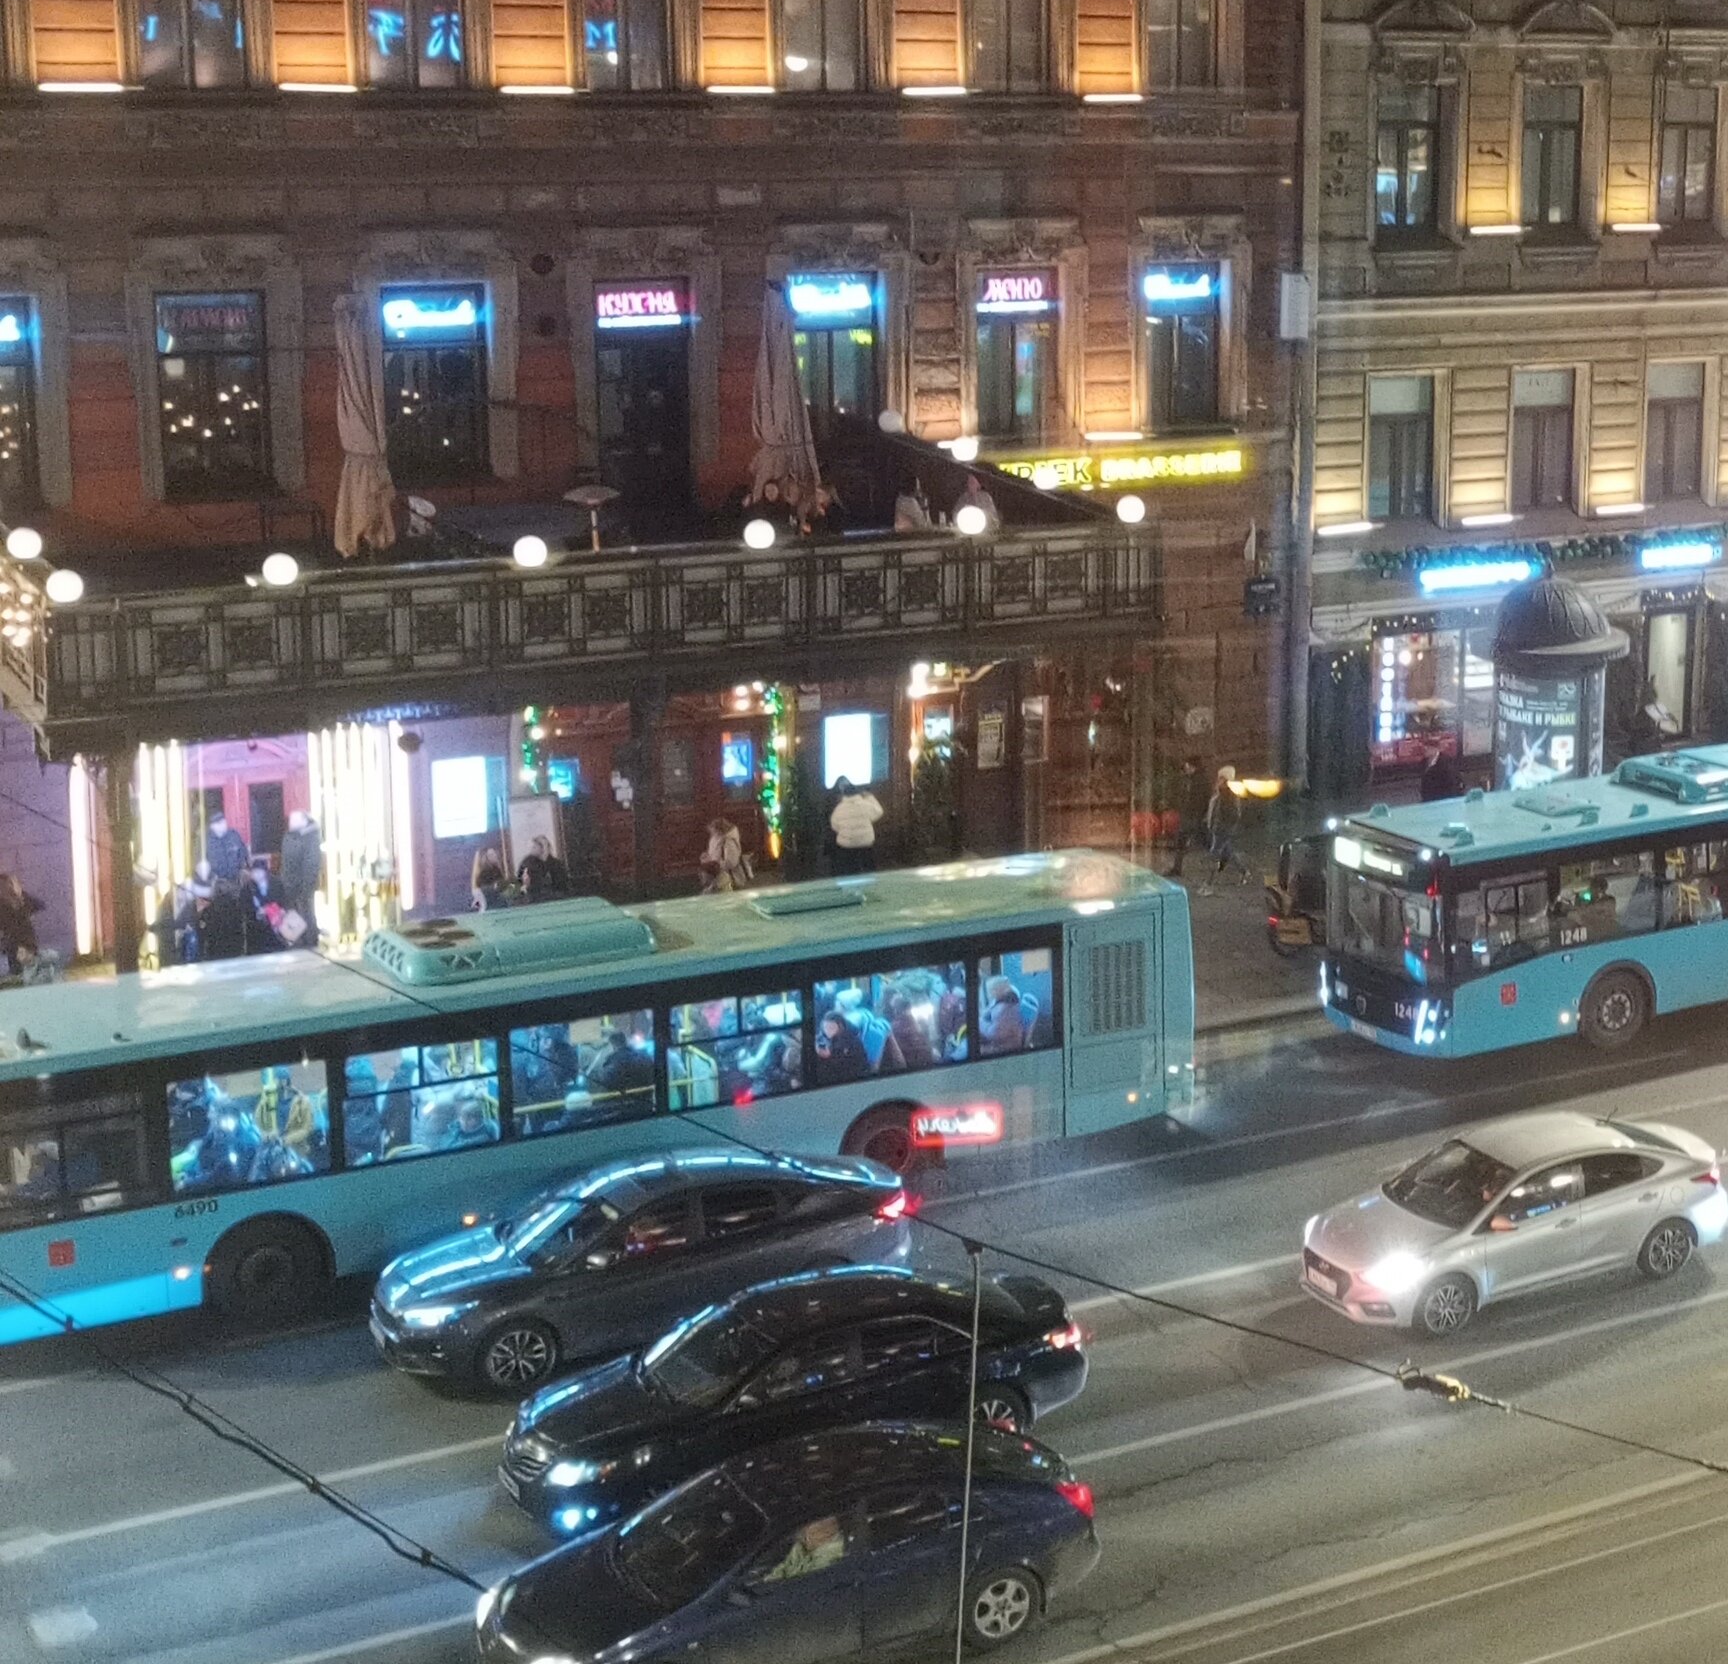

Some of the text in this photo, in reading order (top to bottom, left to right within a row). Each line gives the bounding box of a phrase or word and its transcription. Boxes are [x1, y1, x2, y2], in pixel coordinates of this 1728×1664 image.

[598, 290, 678, 316] КУХНЯ
[1100, 450, 1242, 482] BRASSERIE
[1544, 712, 1576, 727] РЫБКЕ
